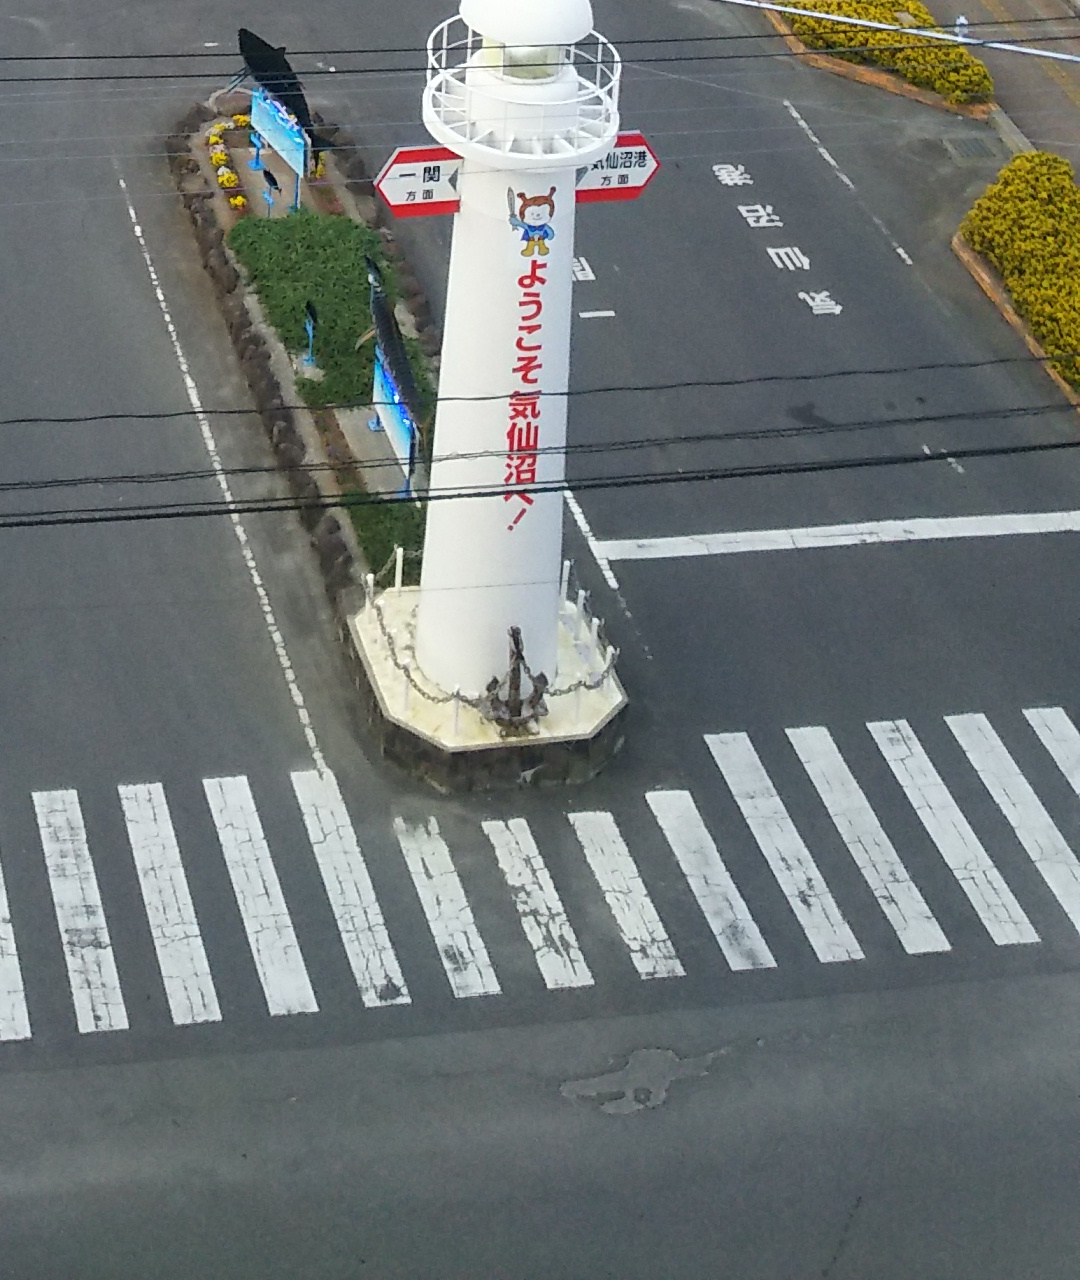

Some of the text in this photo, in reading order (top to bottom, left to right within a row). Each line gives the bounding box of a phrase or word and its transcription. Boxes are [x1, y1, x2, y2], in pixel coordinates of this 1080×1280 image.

[398, 165, 441, 184] 一関
[600, 174, 629, 187] 方面
[405, 188, 434, 202] 方面
